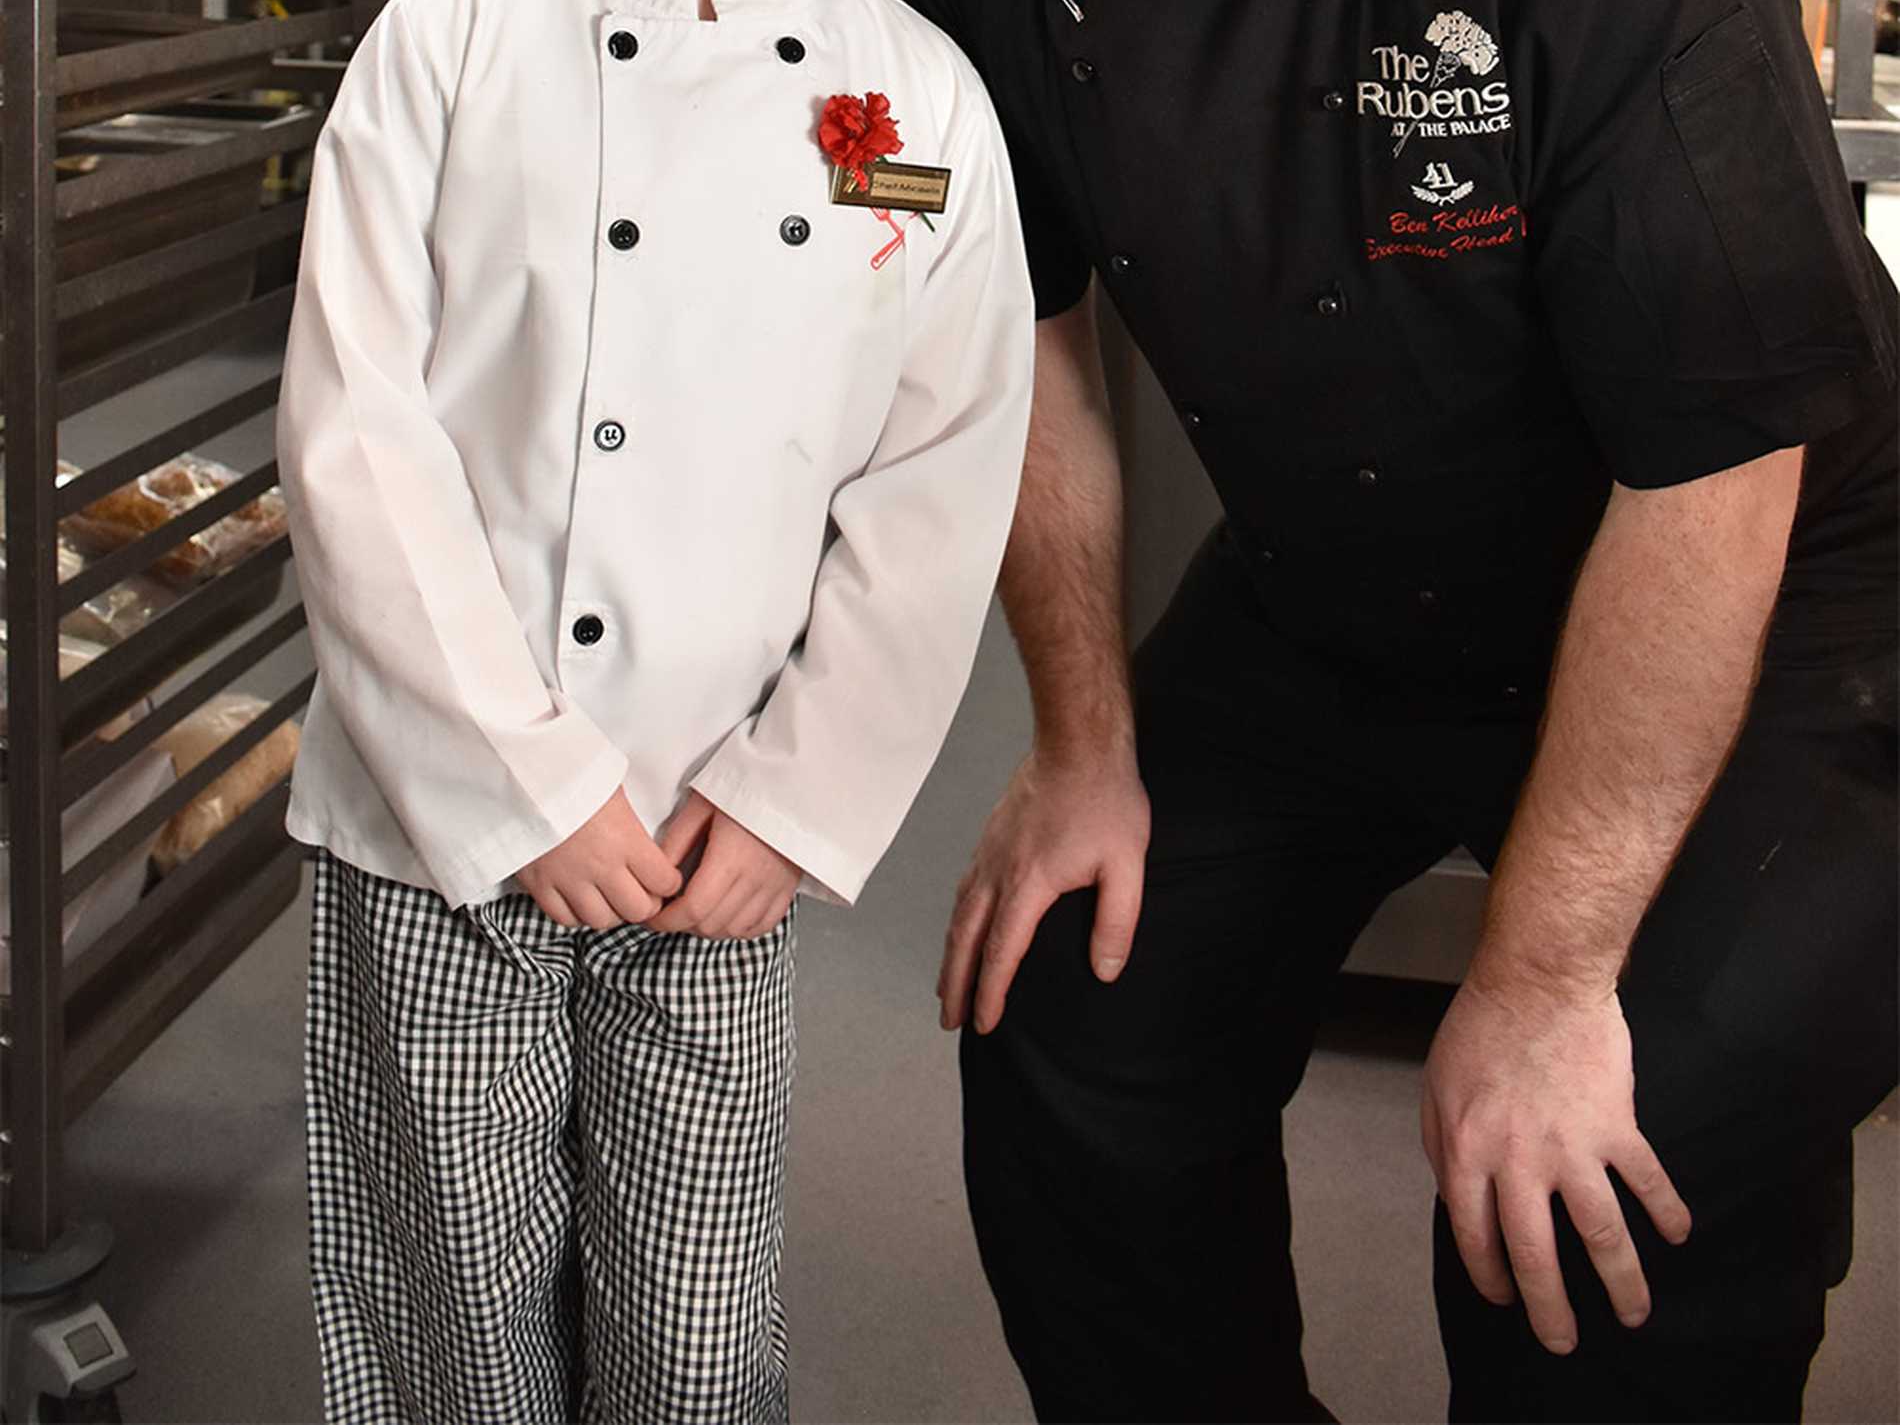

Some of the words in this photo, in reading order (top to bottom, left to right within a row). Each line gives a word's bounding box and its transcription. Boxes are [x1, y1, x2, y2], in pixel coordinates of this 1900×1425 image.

[1371, 45, 1430, 82] The
[1356, 81, 1510, 119] Rubens
[1418, 123, 1448, 137] THE
[1450, 114, 1512, 136] PALACE
[1389, 212, 1428, 235] Ben
